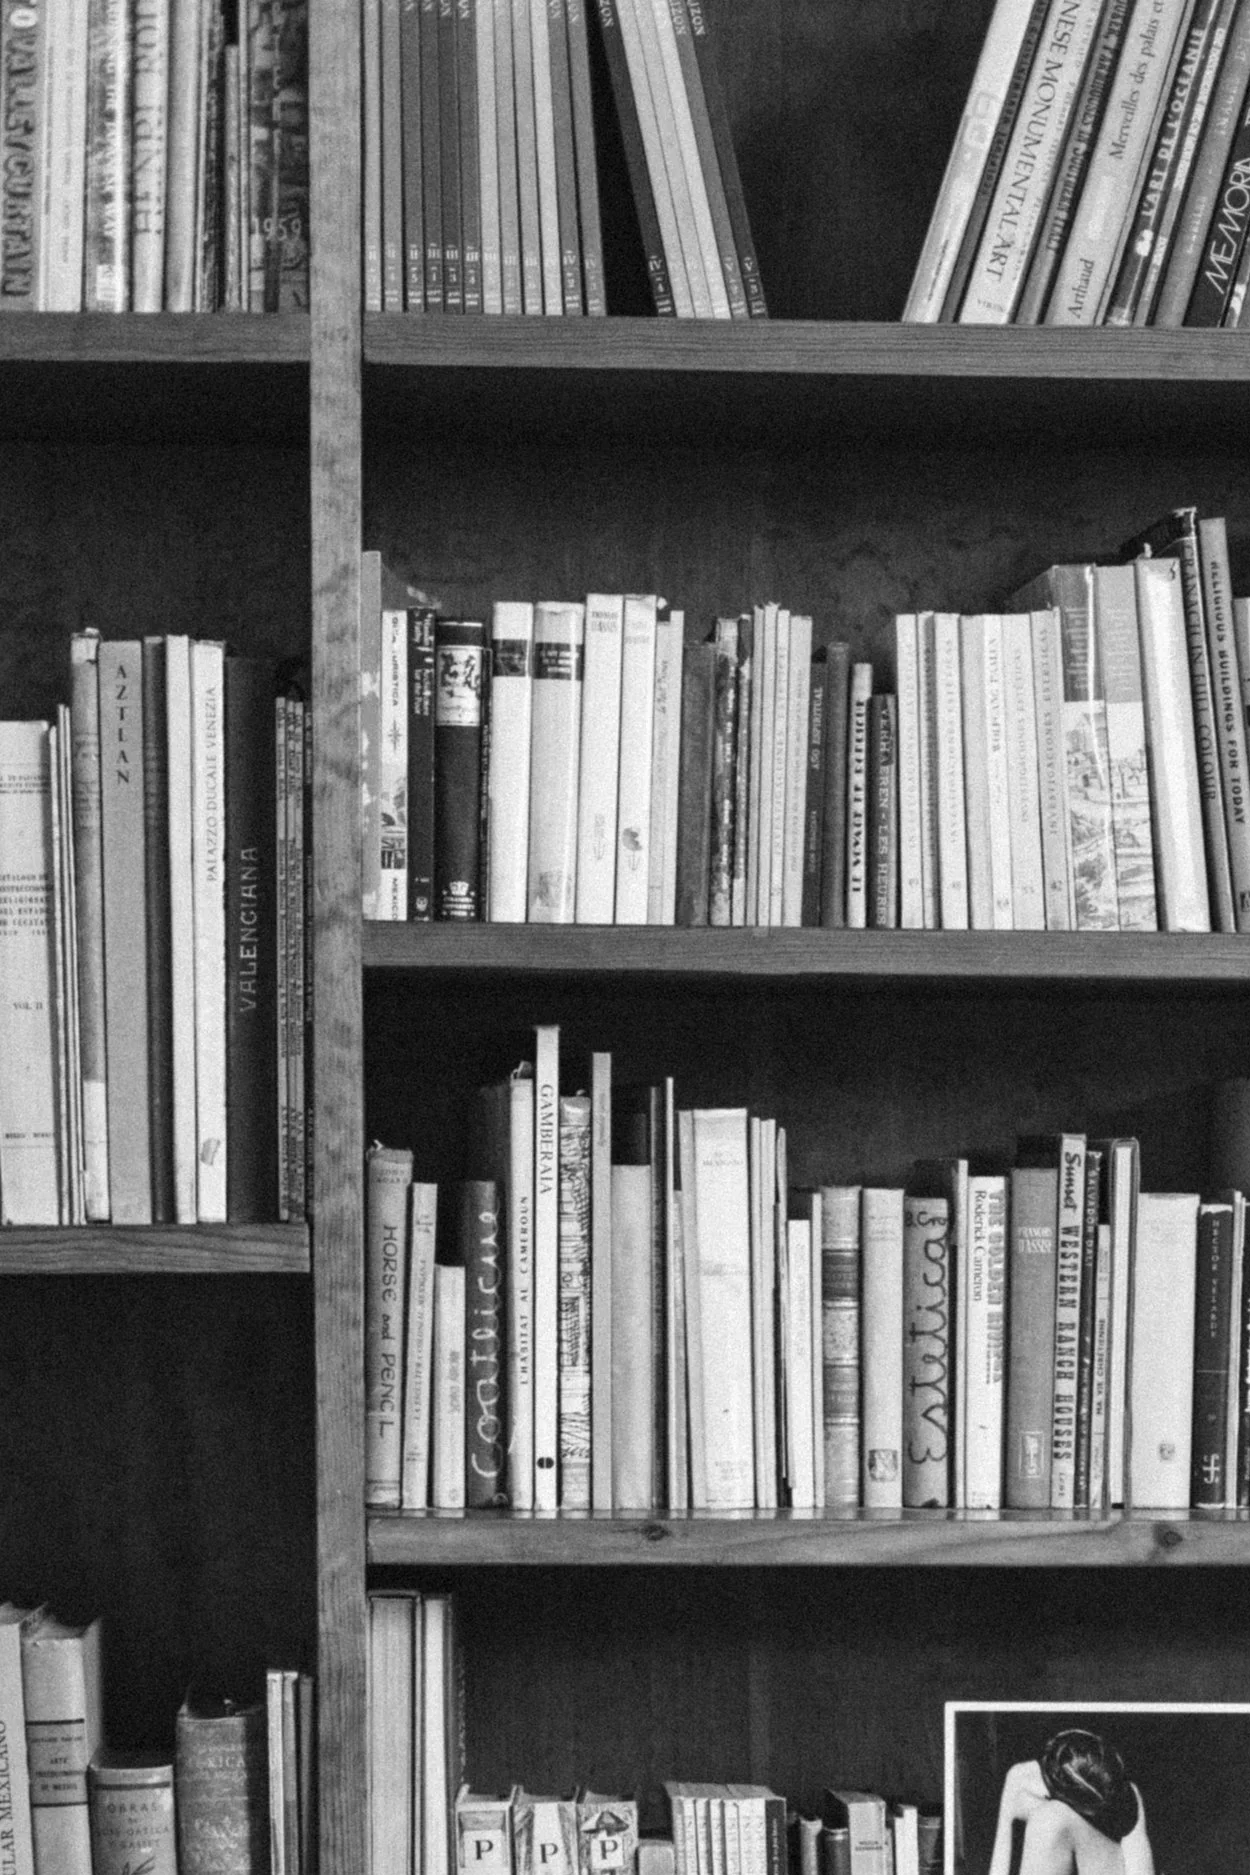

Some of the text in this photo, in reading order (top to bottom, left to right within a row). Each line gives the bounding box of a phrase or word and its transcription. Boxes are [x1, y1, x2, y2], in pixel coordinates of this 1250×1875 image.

[1, 35, 37, 298] VALLEY CURTAIN
[983, 57, 1063, 283] MONUMENTAL ART
[1064, 16, 1164, 318] Arthaud Merveilles des palais
[1140, 135, 1175, 218] L'ART DE
[252, 216, 302, 241] 1959
[1189, 643, 1204, 664] IN
[1209, 559, 1246, 824] RELIGIOUS BUILDINGS FOR TODAY
[115, 664, 130, 786] AZTLAN
[811, 686, 822, 744] ESPIRITUAL
[1195, 721, 1217, 803] COLOUR
[202, 684, 219, 882] PALAZZO DUCALE VENEZIA
[873, 707, 893, 925] VERHAEREN LES HEURES
[1042, 709, 1060, 834] INVESTIGACIONES
[236, 846, 260, 1012] VALENCIANA
[390, 877, 400, 920] MEXICO
[539, 1083, 554, 1193] GAMBERAIA
[972, 1189, 987, 1302] Roderick Cameron
[1085, 1168, 1097, 1234] SALVADOR
[380, 1224, 399, 1340] HORSE and
[519, 1194, 528, 1384] L'HABITAT CAMEROUN
[1051, 1151, 1083, 1462] Sunset WESTERN RANCH HOUSES
[1095, 1400, 1103, 1415] MA
[0, 1718, 12, 1821] MEXICANO
[107, 1803, 158, 1814] OBRAS
[474, 1839, 493, 1860] P
[540, 1842, 558, 1864] P
[600, 1838, 618, 1860] P
